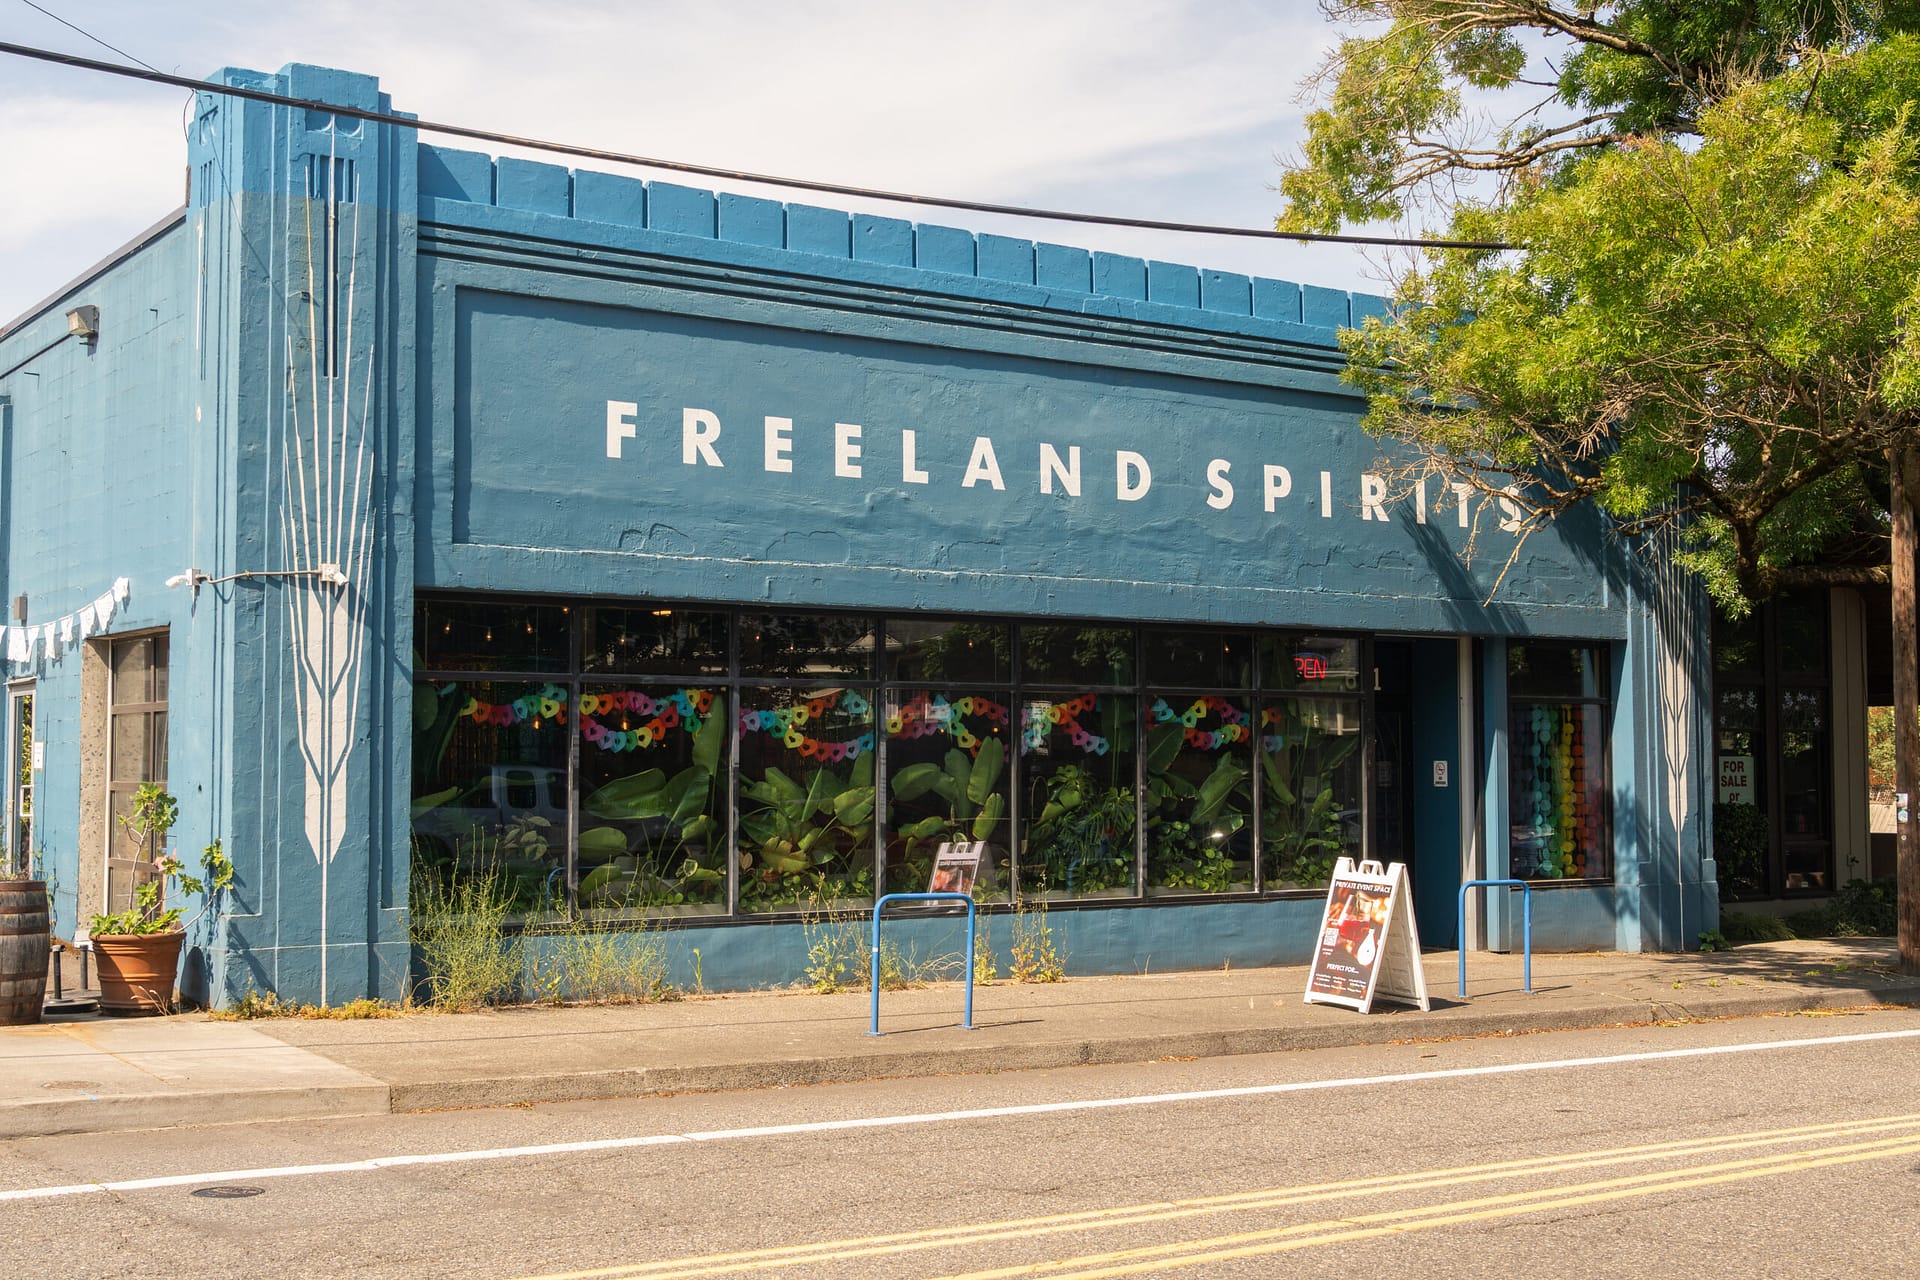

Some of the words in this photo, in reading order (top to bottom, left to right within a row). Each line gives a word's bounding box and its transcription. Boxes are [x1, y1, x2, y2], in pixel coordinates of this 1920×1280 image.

[606, 400, 1152, 501] FREELAND
[1206, 458, 1523, 532] SPIRITS
[1293, 657, 1326, 679] PEN
[1723, 760, 1745, 773] FOR
[1720, 775, 1748, 788] SALE
[1729, 792, 1740, 803] or
[1335, 880, 1357, 890] PRIVATE
[1356, 883, 1374, 891] EVENT
[1373, 885, 1392, 894] SPACE
